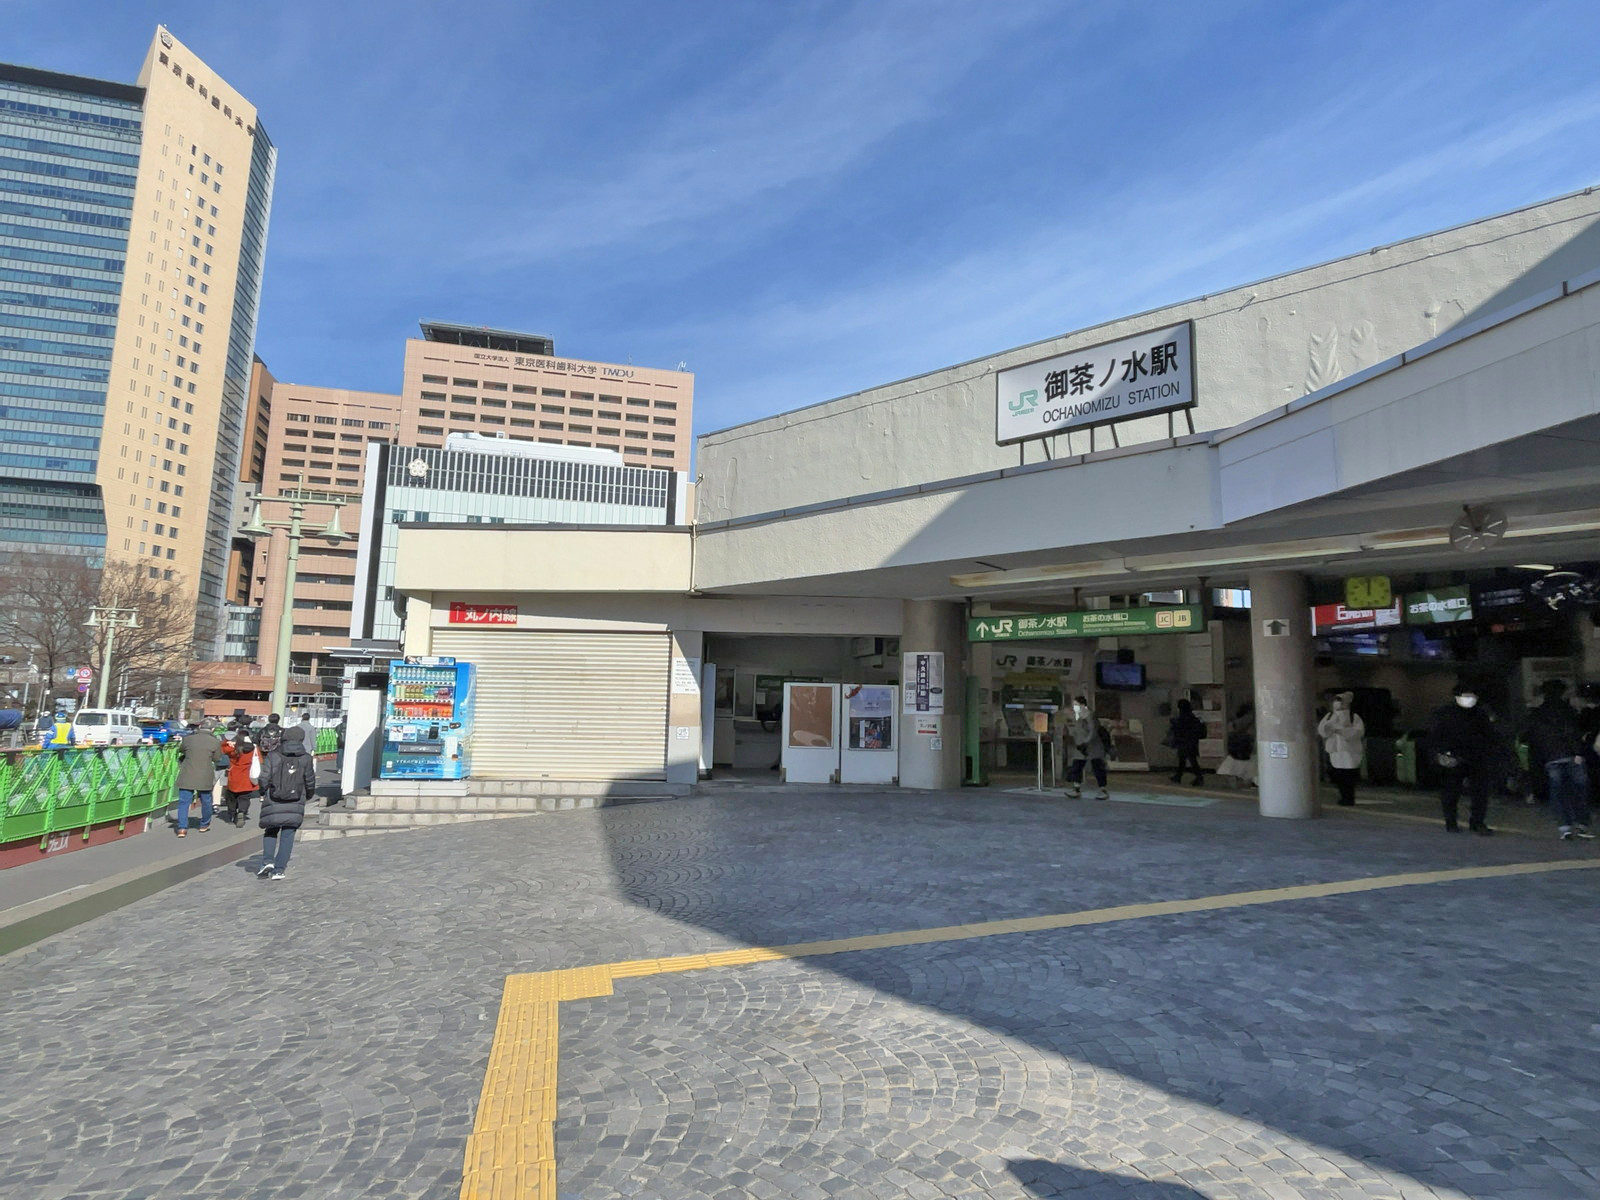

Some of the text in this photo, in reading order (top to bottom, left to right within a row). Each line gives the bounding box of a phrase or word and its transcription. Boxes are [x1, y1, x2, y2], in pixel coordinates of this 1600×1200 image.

[514, 356, 597, 375] 東京医科歯科大学
[602, 367, 634, 378] TMDU
[1045, 341, 1177, 402] 御茶ノ水駅
[1009, 390, 1038, 410] JR
[1043, 382, 1179, 424] OCHANOMIZU STATION
[464, 607, 517, 622] 丸ノ内線
[1160, 615, 1169, 623] JC
[992, 620, 1012, 633] JR
[1018, 616, 1068, 629] 御茶ノ水駅
[996, 655, 1018, 666] JR
